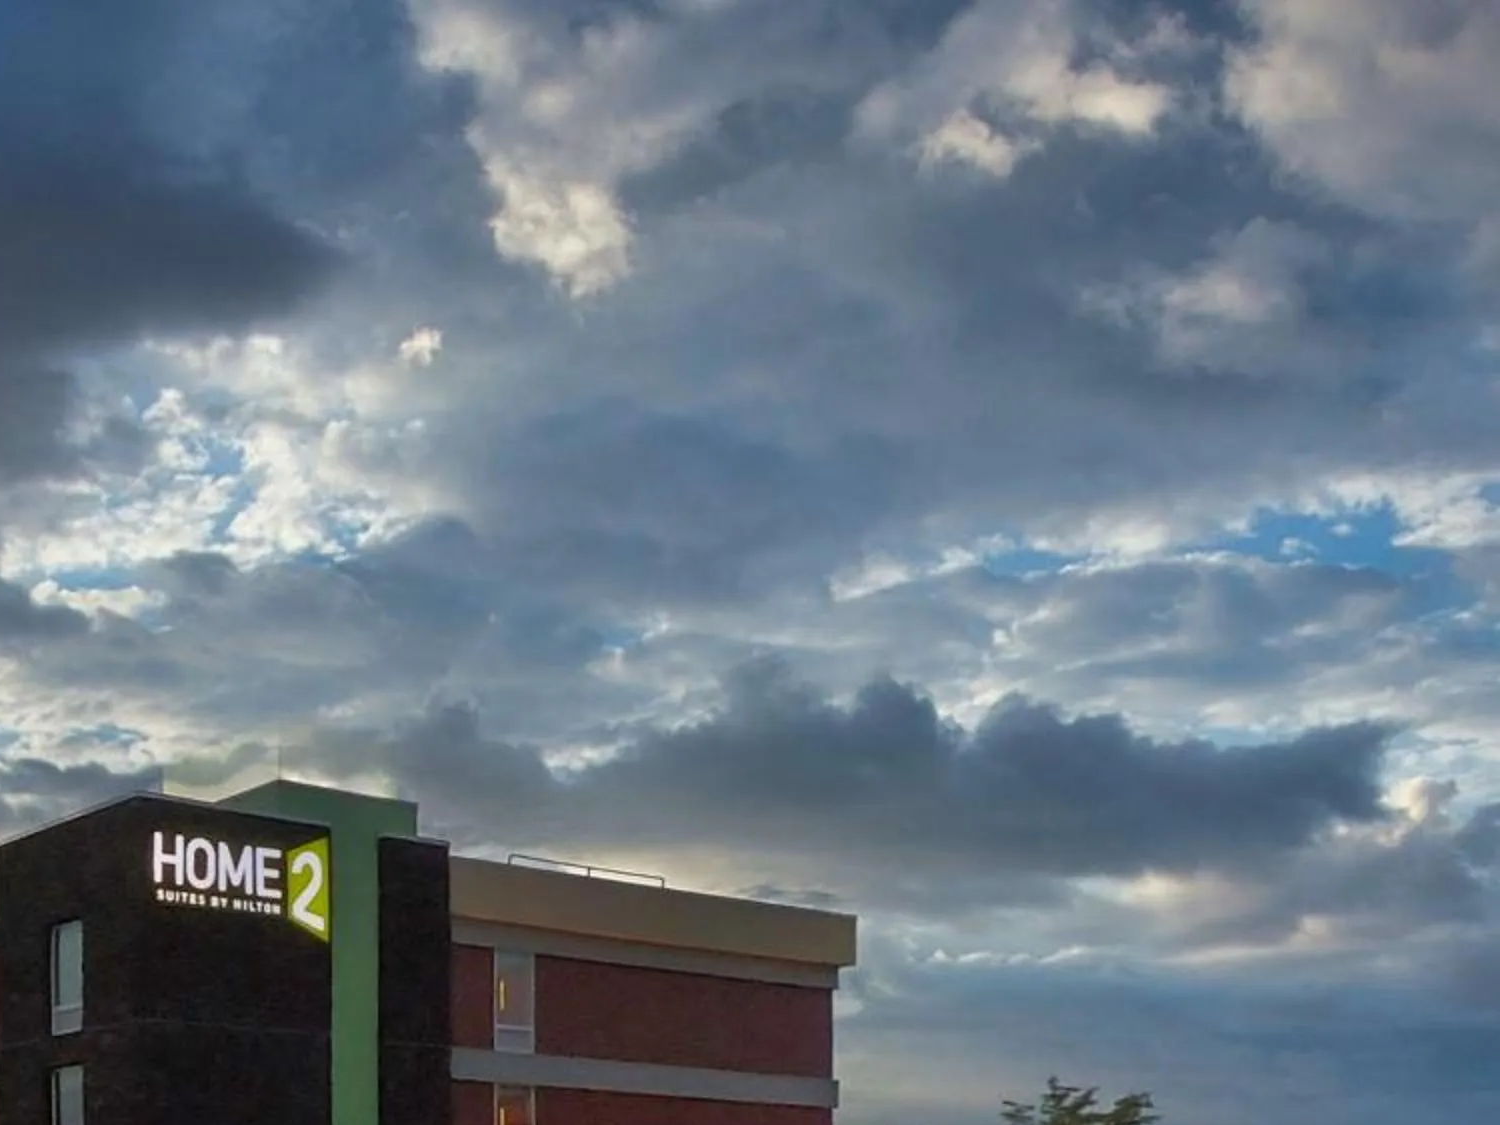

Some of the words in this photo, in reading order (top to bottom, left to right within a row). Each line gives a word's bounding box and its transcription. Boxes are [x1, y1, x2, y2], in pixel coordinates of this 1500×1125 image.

[153, 831, 283, 899] HOME
[291, 851, 325, 931] 2
[156, 888, 206, 906] SUITES
[210, 896, 228, 908] BY
[233, 898, 282, 915] HILTON
